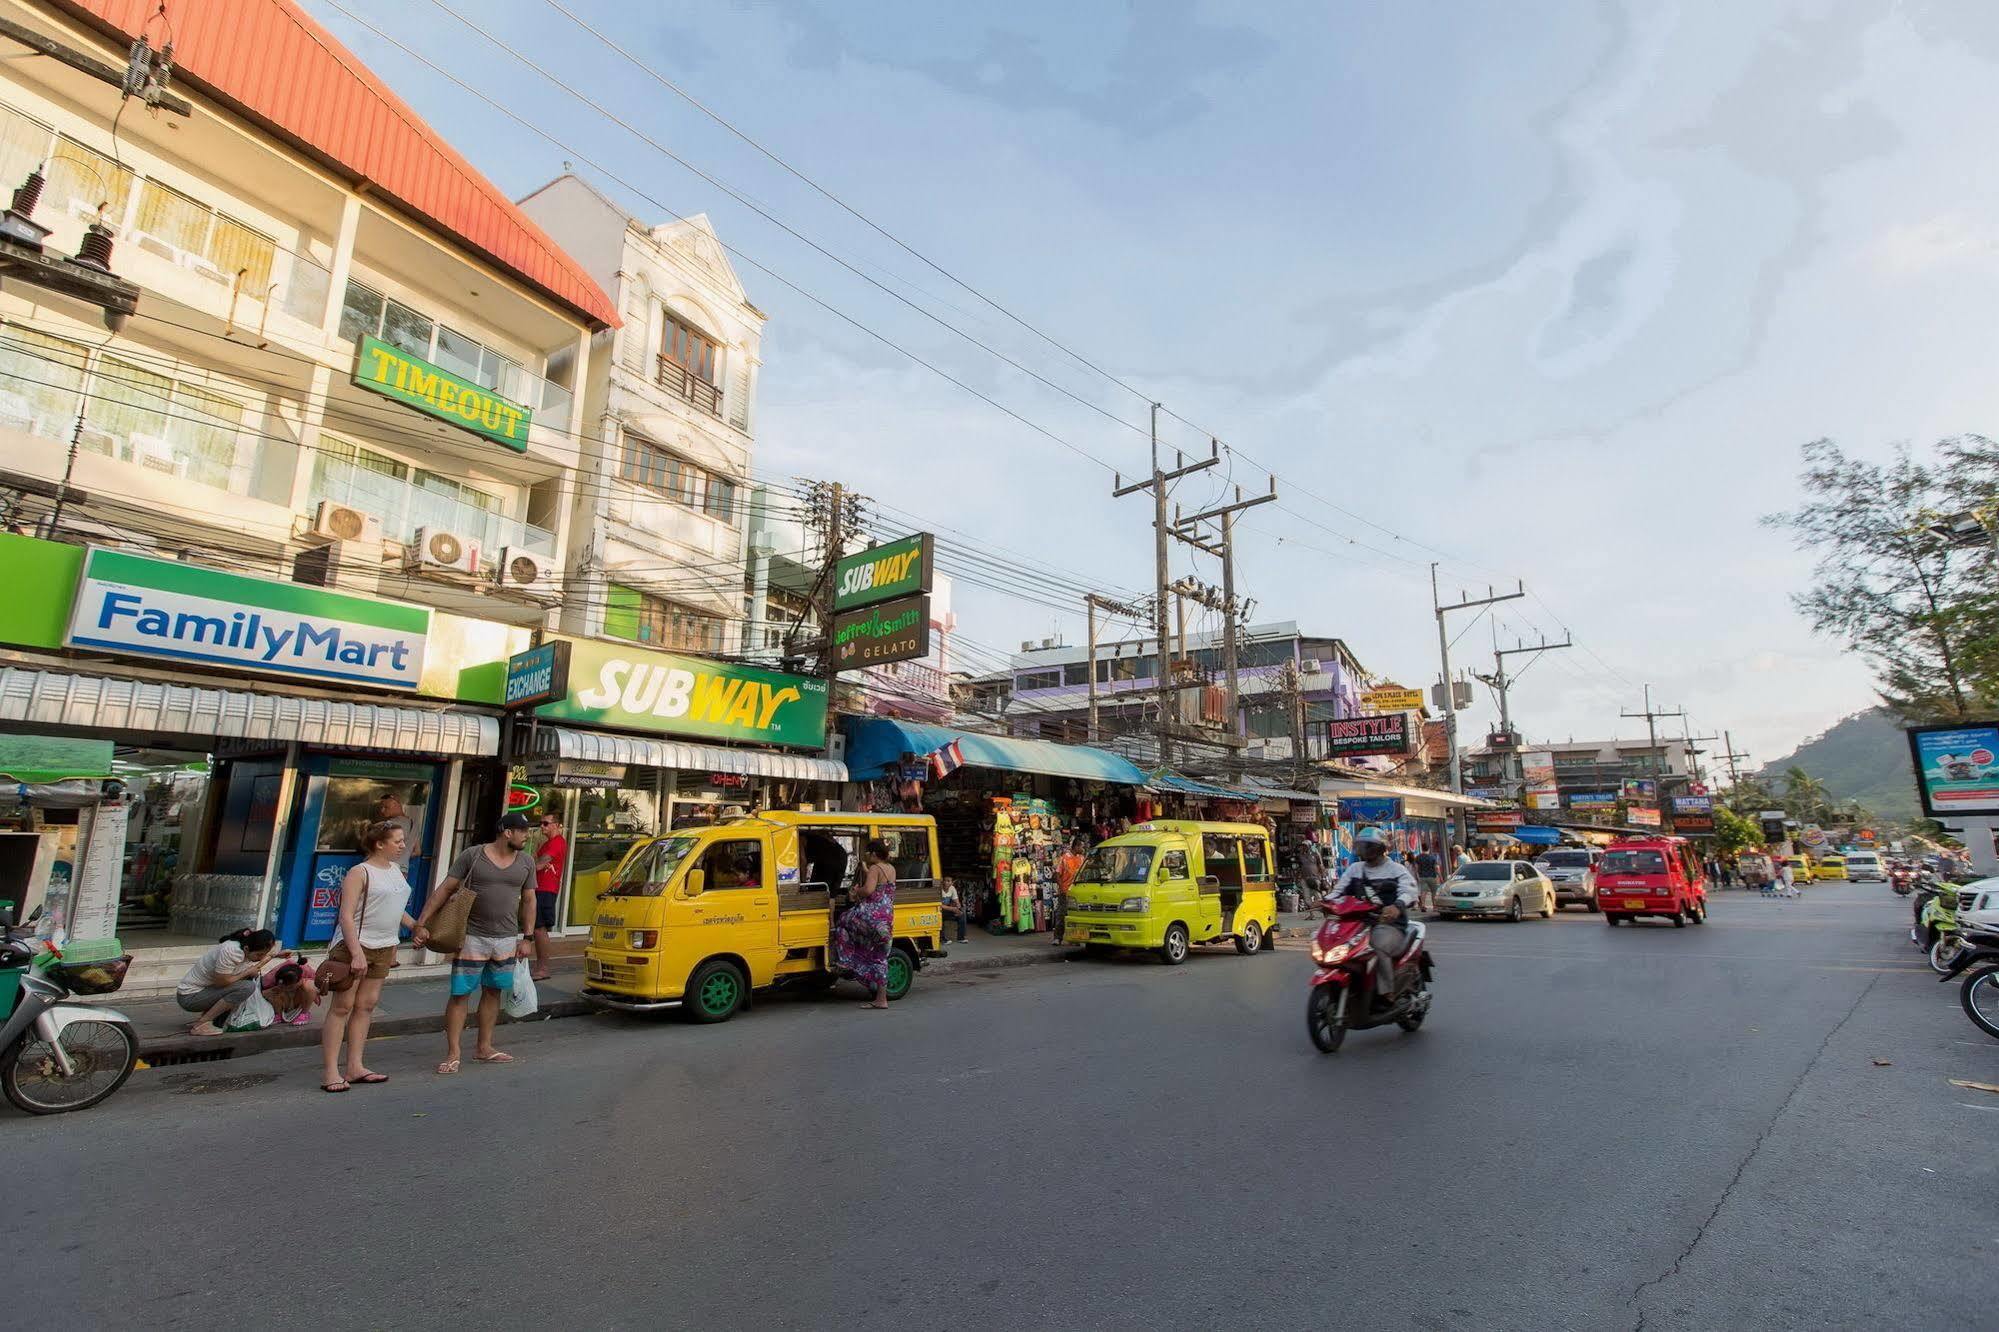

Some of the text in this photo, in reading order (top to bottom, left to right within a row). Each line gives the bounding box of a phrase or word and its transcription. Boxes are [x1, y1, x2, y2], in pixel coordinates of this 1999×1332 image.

[371, 348, 523, 439] TIMEOUT
[838, 548, 919, 598] SUBWAY
[97, 591, 410, 671] FamilyMart
[864, 640, 916, 658] GELATO
[507, 667, 551, 701] EXCHANGE
[577, 659, 800, 729] SUBWAY
[1330, 717, 1403, 738] INSTYLE
[1333, 733, 1401, 745] BESPOKE TAILORS
